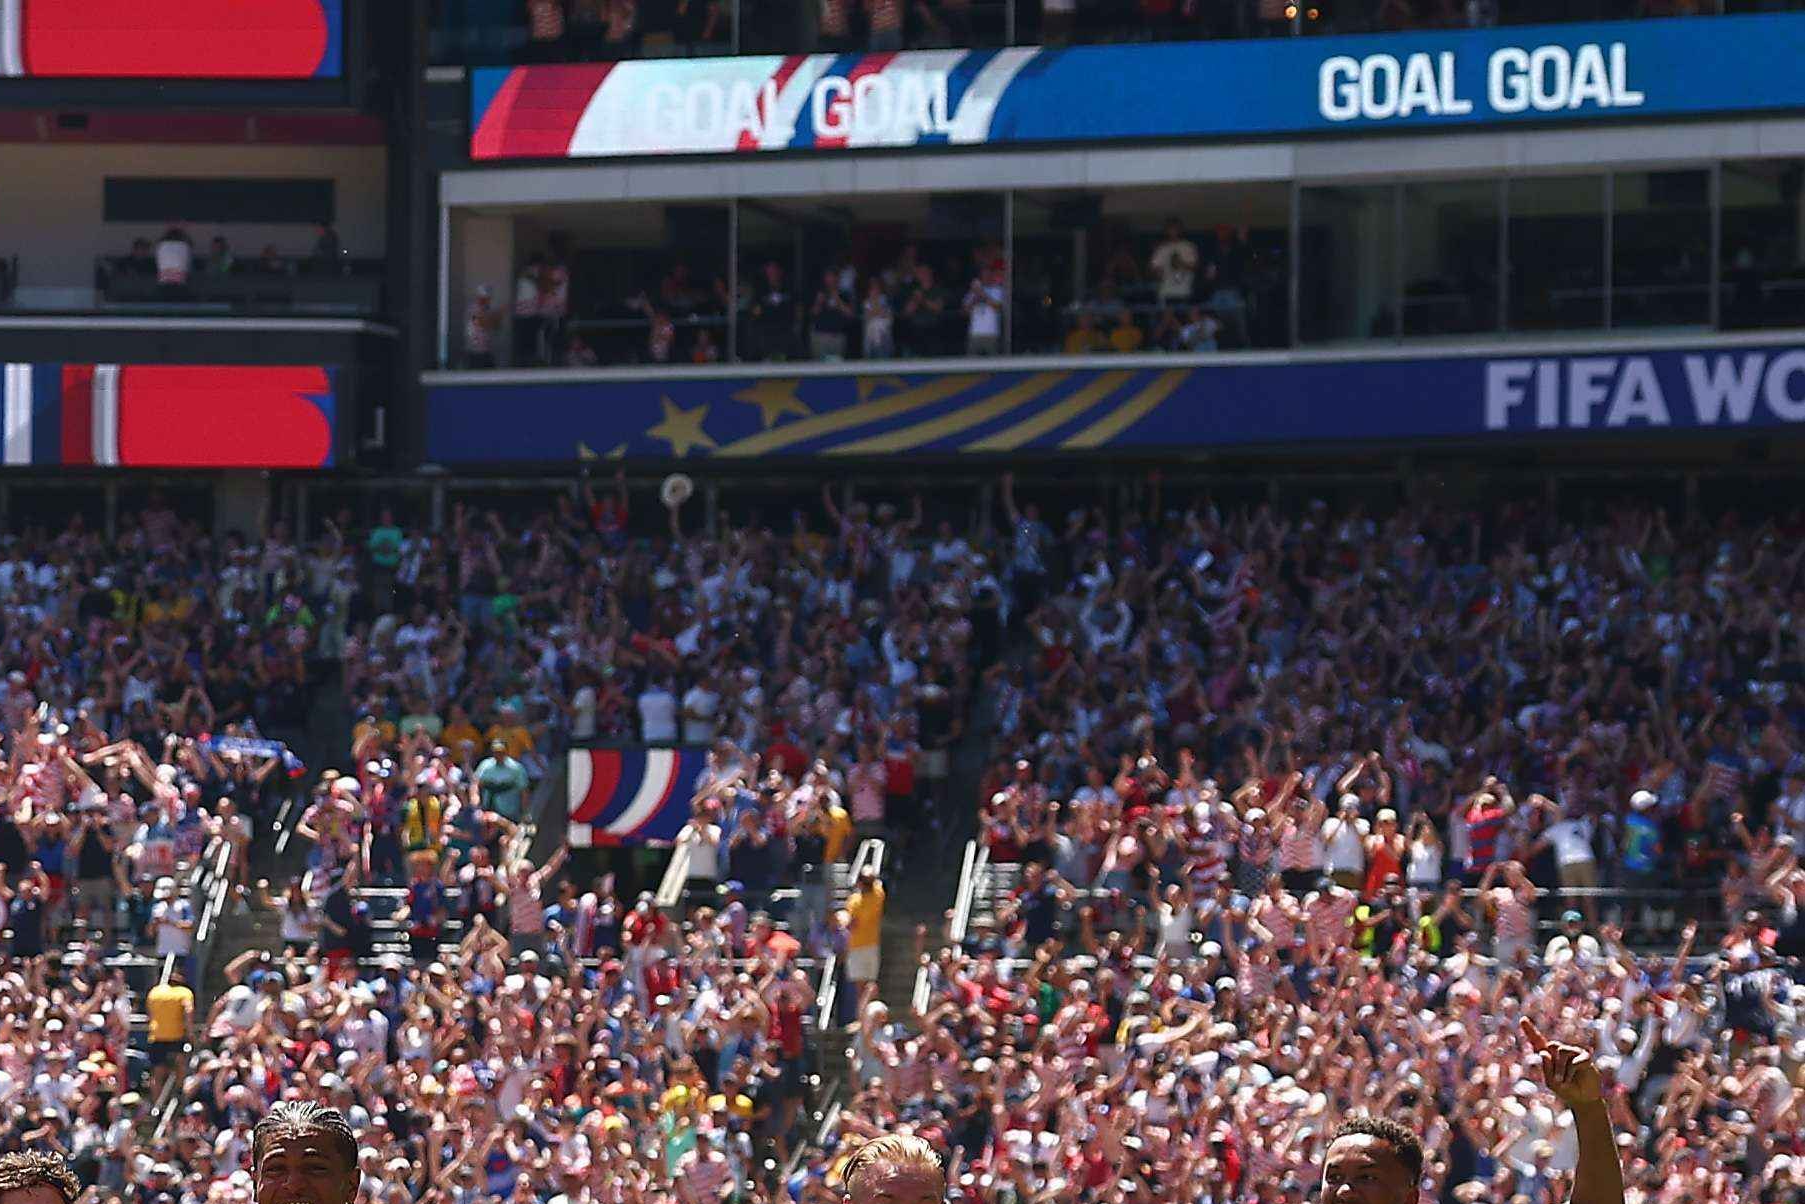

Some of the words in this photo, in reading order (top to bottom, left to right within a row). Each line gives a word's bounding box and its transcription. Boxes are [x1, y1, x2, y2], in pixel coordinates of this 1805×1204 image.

[647, 77, 793, 140] GOAL
[814, 70, 964, 136] GOAL
[1318, 50, 1473, 121] GOAL
[1487, 41, 1645, 113] GOAL
[1485, 355, 1671, 430] FIFA
